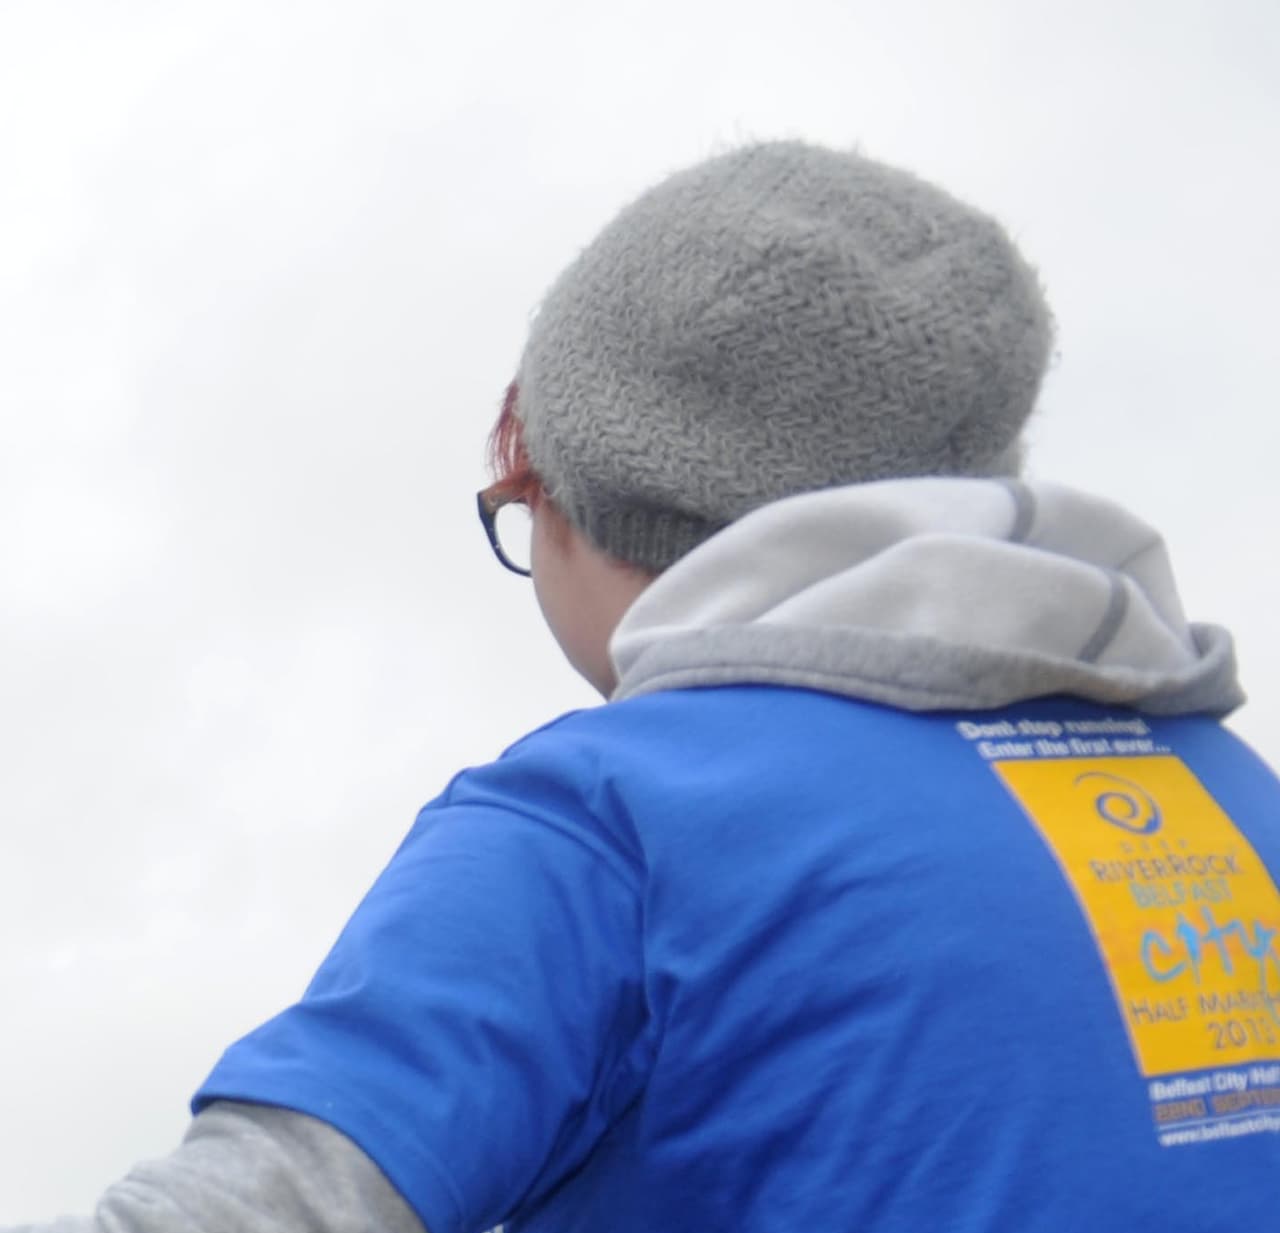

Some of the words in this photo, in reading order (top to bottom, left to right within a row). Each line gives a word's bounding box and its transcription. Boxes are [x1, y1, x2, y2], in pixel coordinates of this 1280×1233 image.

[978, 740, 1033, 760] Enter
[1034, 738, 1069, 756] the
[1069, 737, 1112, 755] first
[1128, 878, 1233, 909] BELFAST
[1148, 1077, 1210, 1102] Belfast
[1212, 1070, 1249, 1092] City
